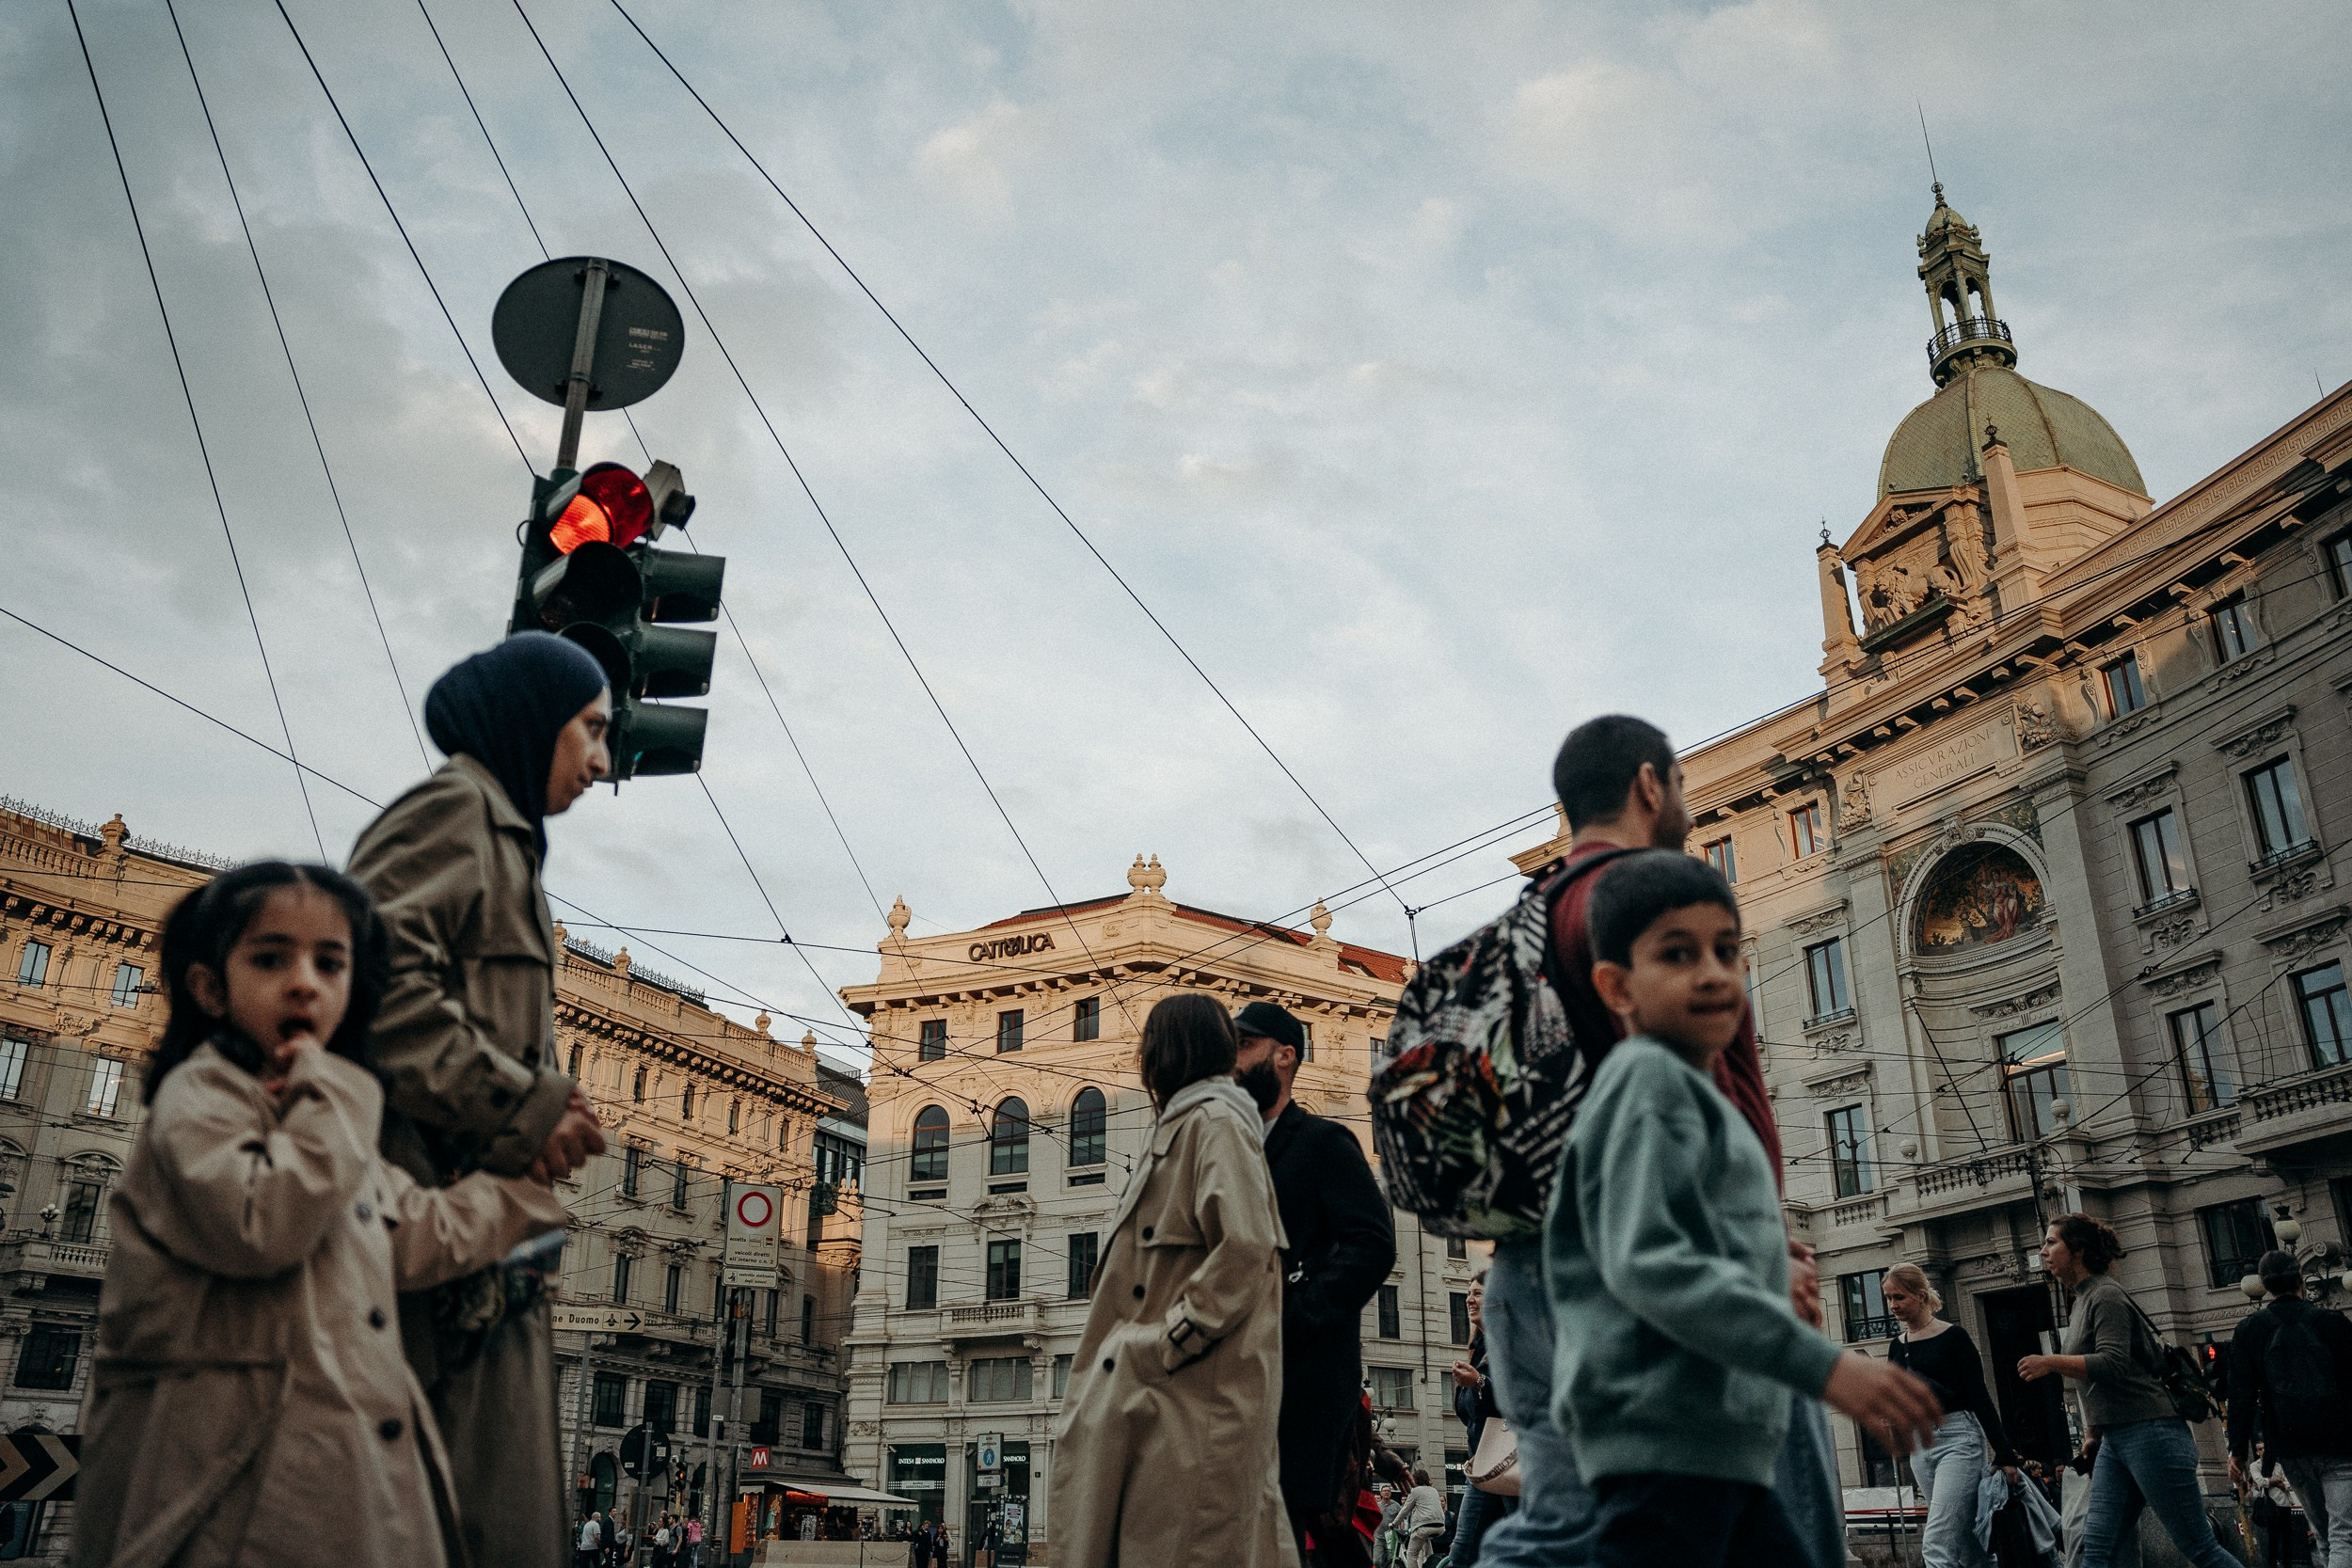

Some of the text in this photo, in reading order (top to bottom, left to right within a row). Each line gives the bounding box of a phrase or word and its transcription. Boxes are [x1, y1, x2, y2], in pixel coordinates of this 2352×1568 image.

[1913, 752, 1975, 789] GENERALI
[968, 932, 1056, 961] CATTOLICA
[568, 1313, 599, 1324] Duomo
[752, 1450, 768, 1465] M
